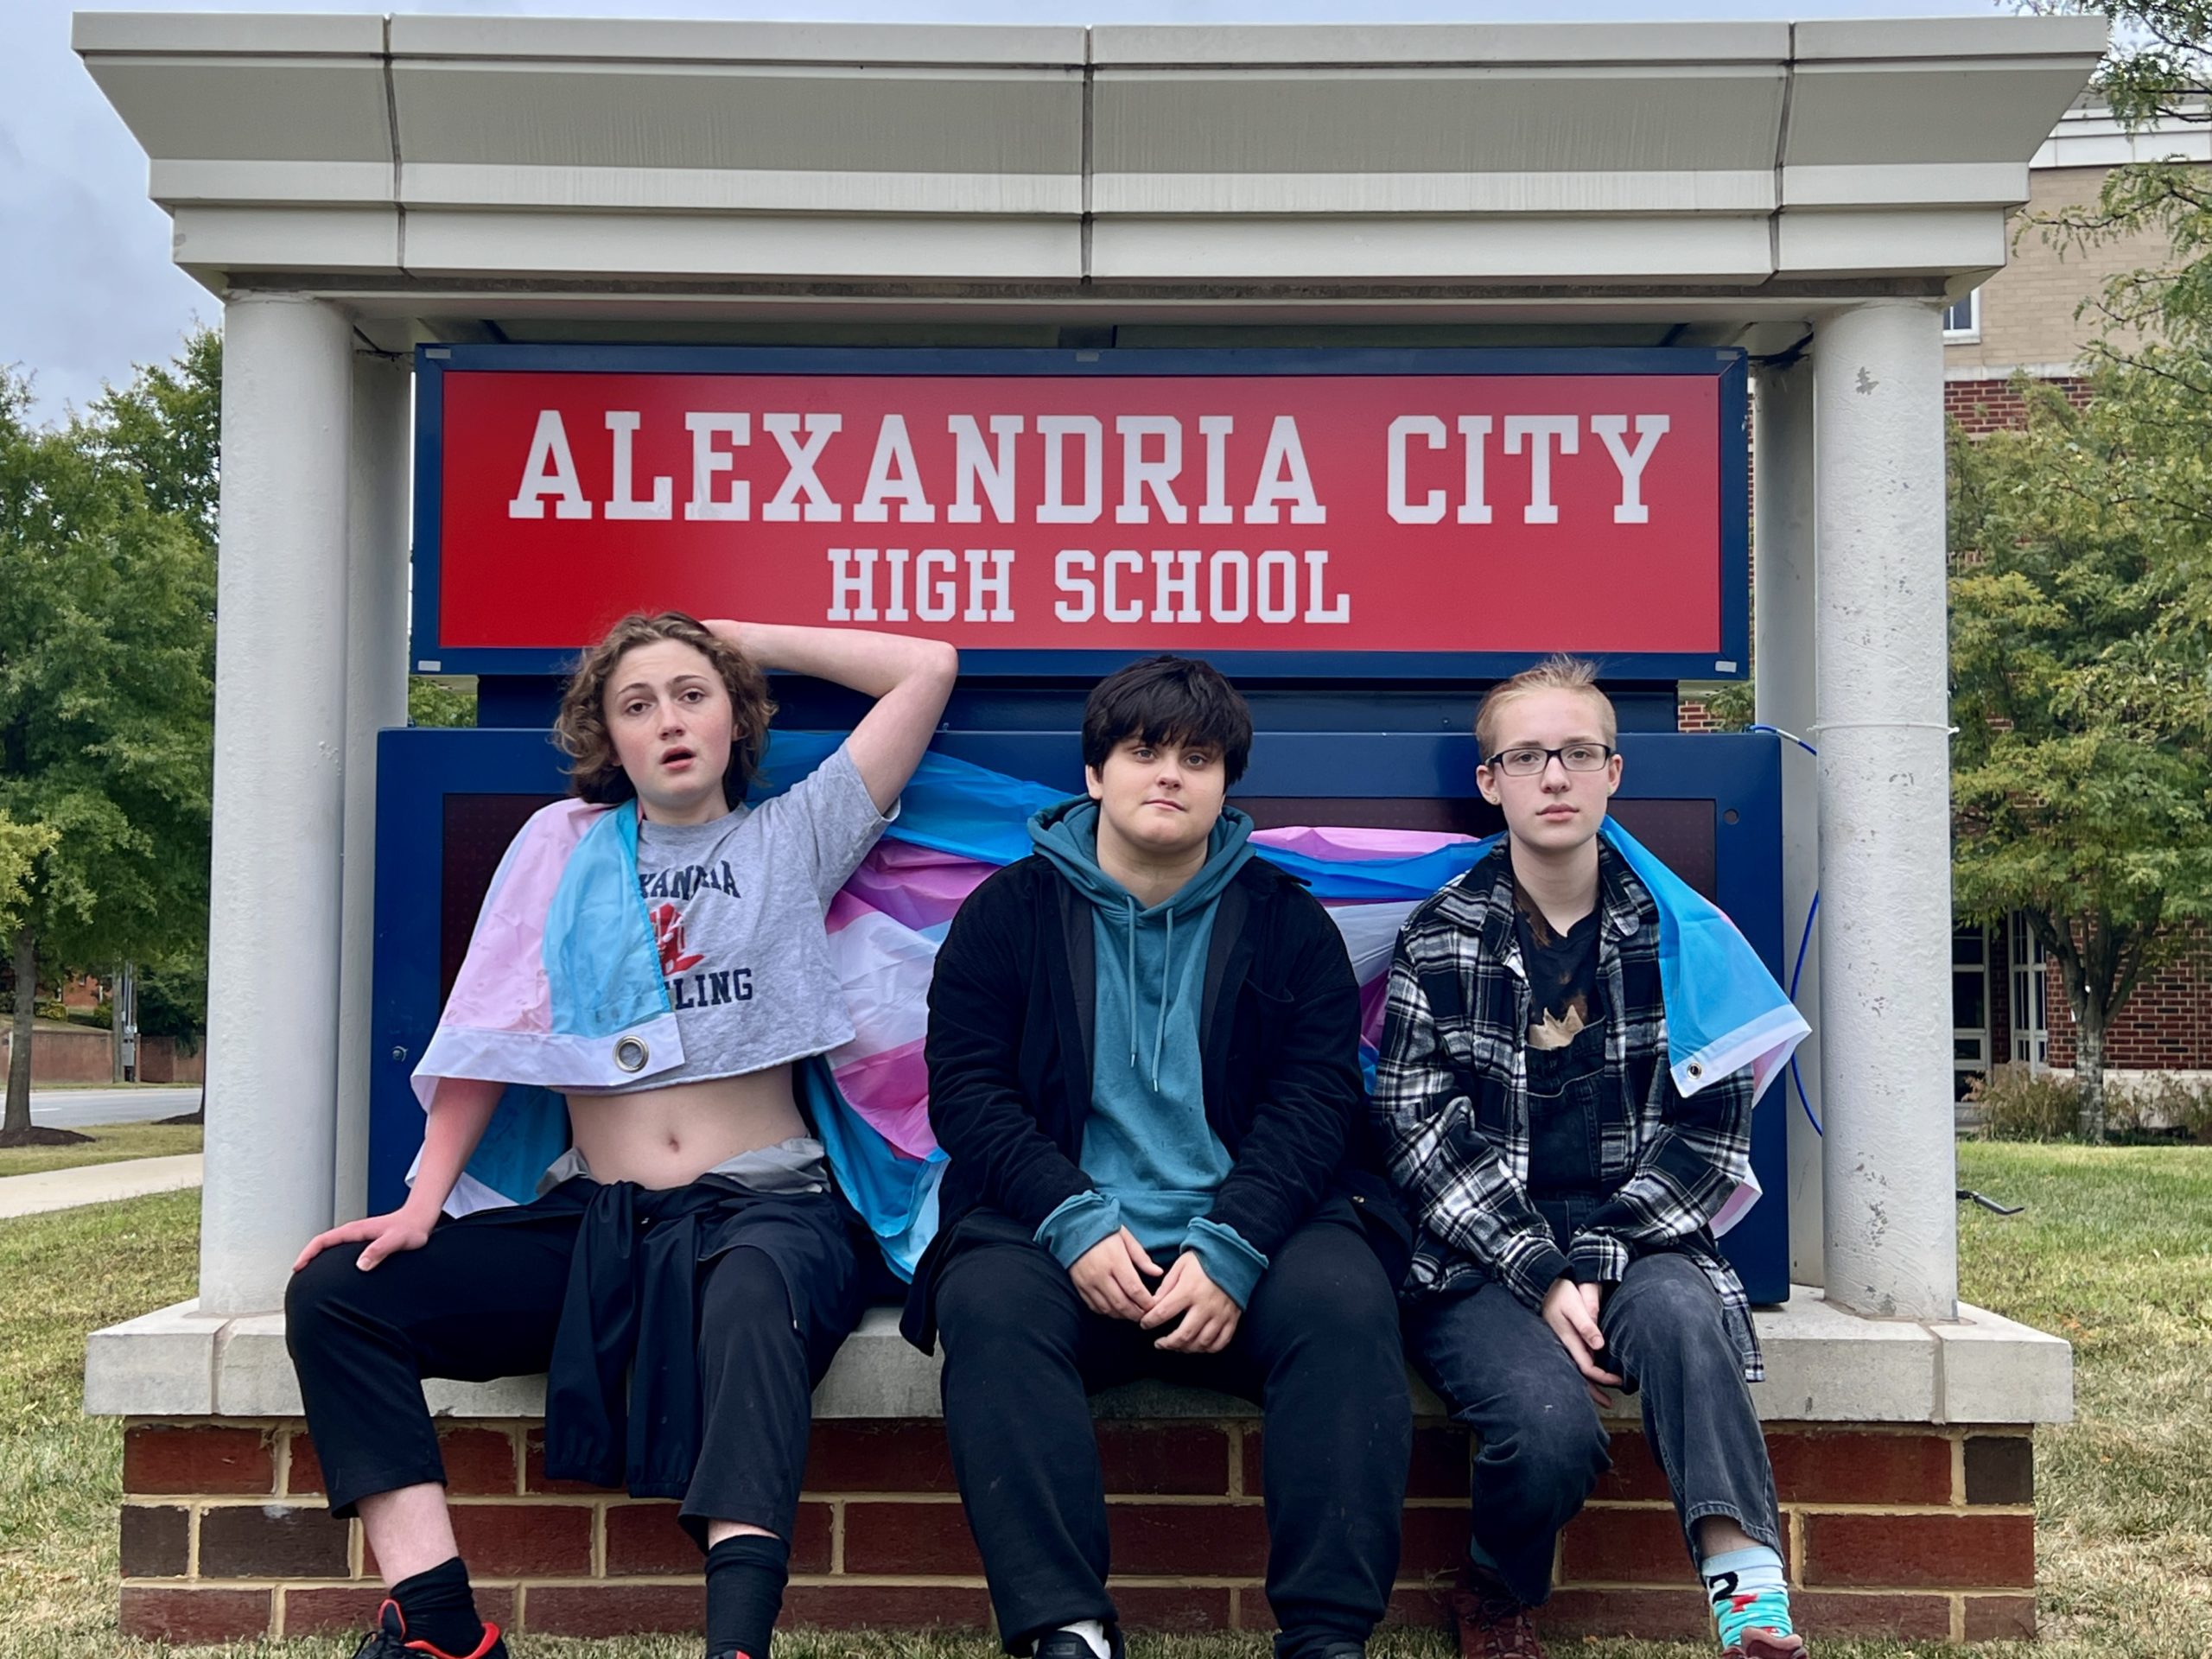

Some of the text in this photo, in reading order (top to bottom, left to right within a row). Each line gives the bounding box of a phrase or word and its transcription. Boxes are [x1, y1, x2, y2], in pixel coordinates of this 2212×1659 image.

[509, 410, 1670, 524] ALEXANDRIA CITY
[827, 548, 1351, 624] HIGH SCHOOL
[664, 968, 753, 1010] LING
